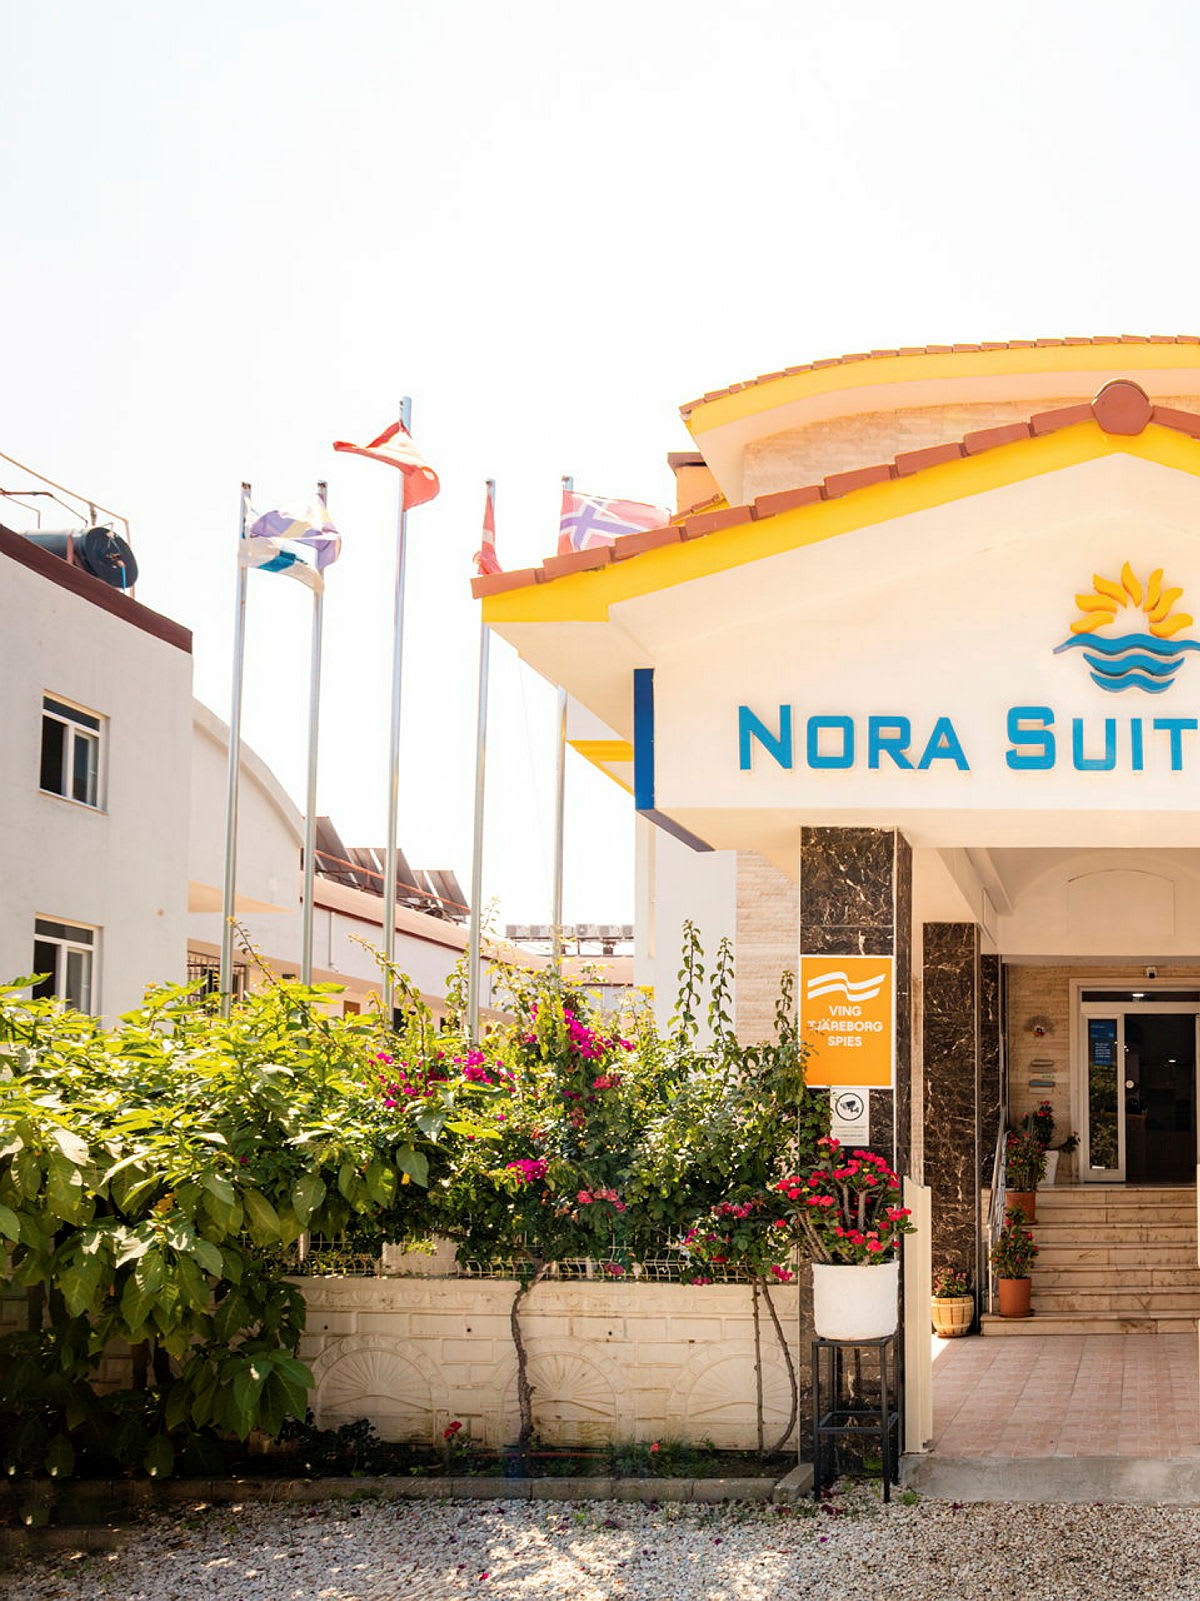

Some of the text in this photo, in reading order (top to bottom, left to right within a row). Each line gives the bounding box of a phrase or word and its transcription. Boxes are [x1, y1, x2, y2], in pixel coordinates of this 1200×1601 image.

[738, 705, 970, 771] NORA
[1006, 706, 1198, 772] SUIT
[829, 1005, 862, 1016] VING
[807, 1018, 883, 1031] TJÄREBORG
[827, 1036, 862, 1047] SPIES
